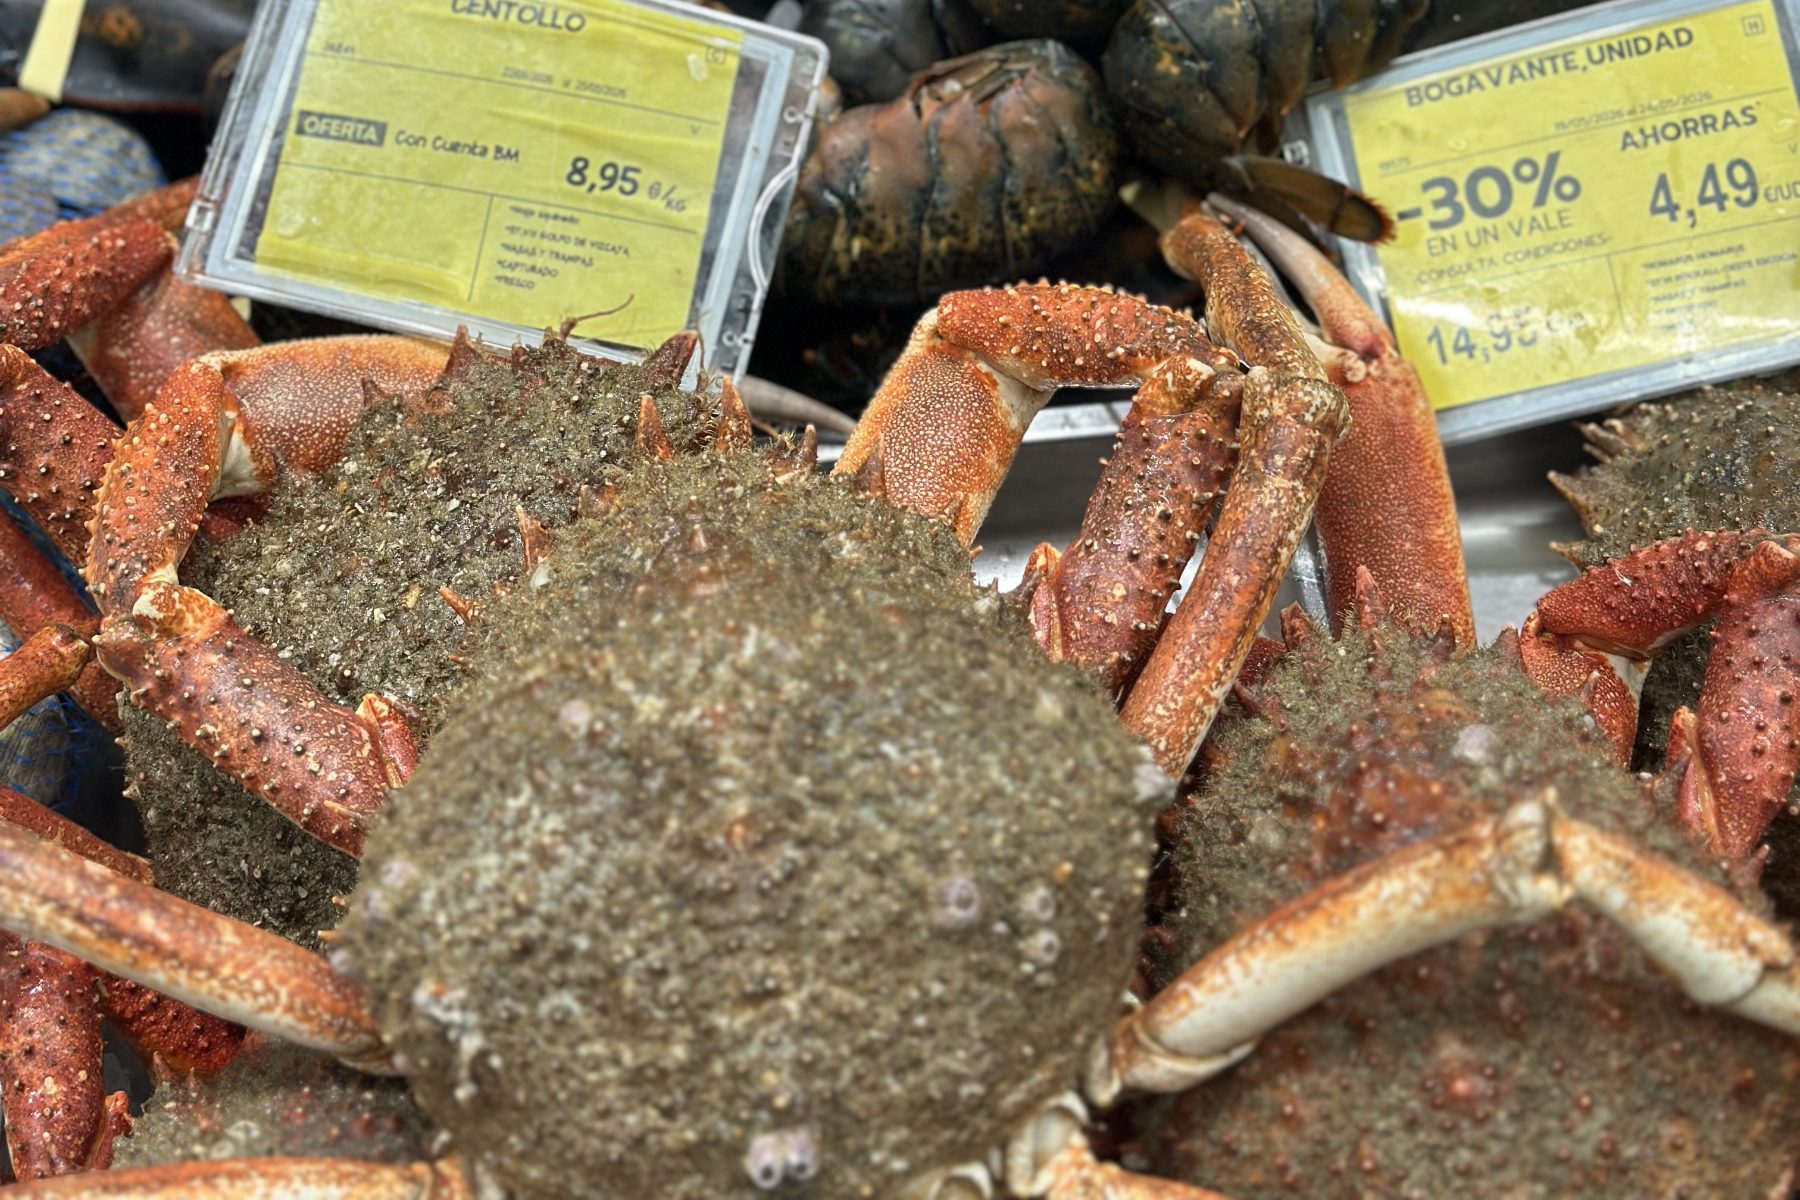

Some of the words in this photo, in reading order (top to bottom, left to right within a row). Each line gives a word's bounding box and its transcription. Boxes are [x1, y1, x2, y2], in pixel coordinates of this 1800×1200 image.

[1405, 27, 1694, 107] BOGAVANTE,UNIDAD
[303, 115, 379, 143] OFERTA
[395, 130, 427, 149] Con
[432, 135, 489, 158] Cuenta
[493, 144, 520, 163] BM
[566, 156, 641, 196] 8,95
[1397, 150, 1582, 231] -30%
[1650, 158, 1758, 228] 4,49
[1426, 234, 1458, 257] EN
[1465, 224, 1499, 249] UN
[1507, 208, 1573, 237] VALE
